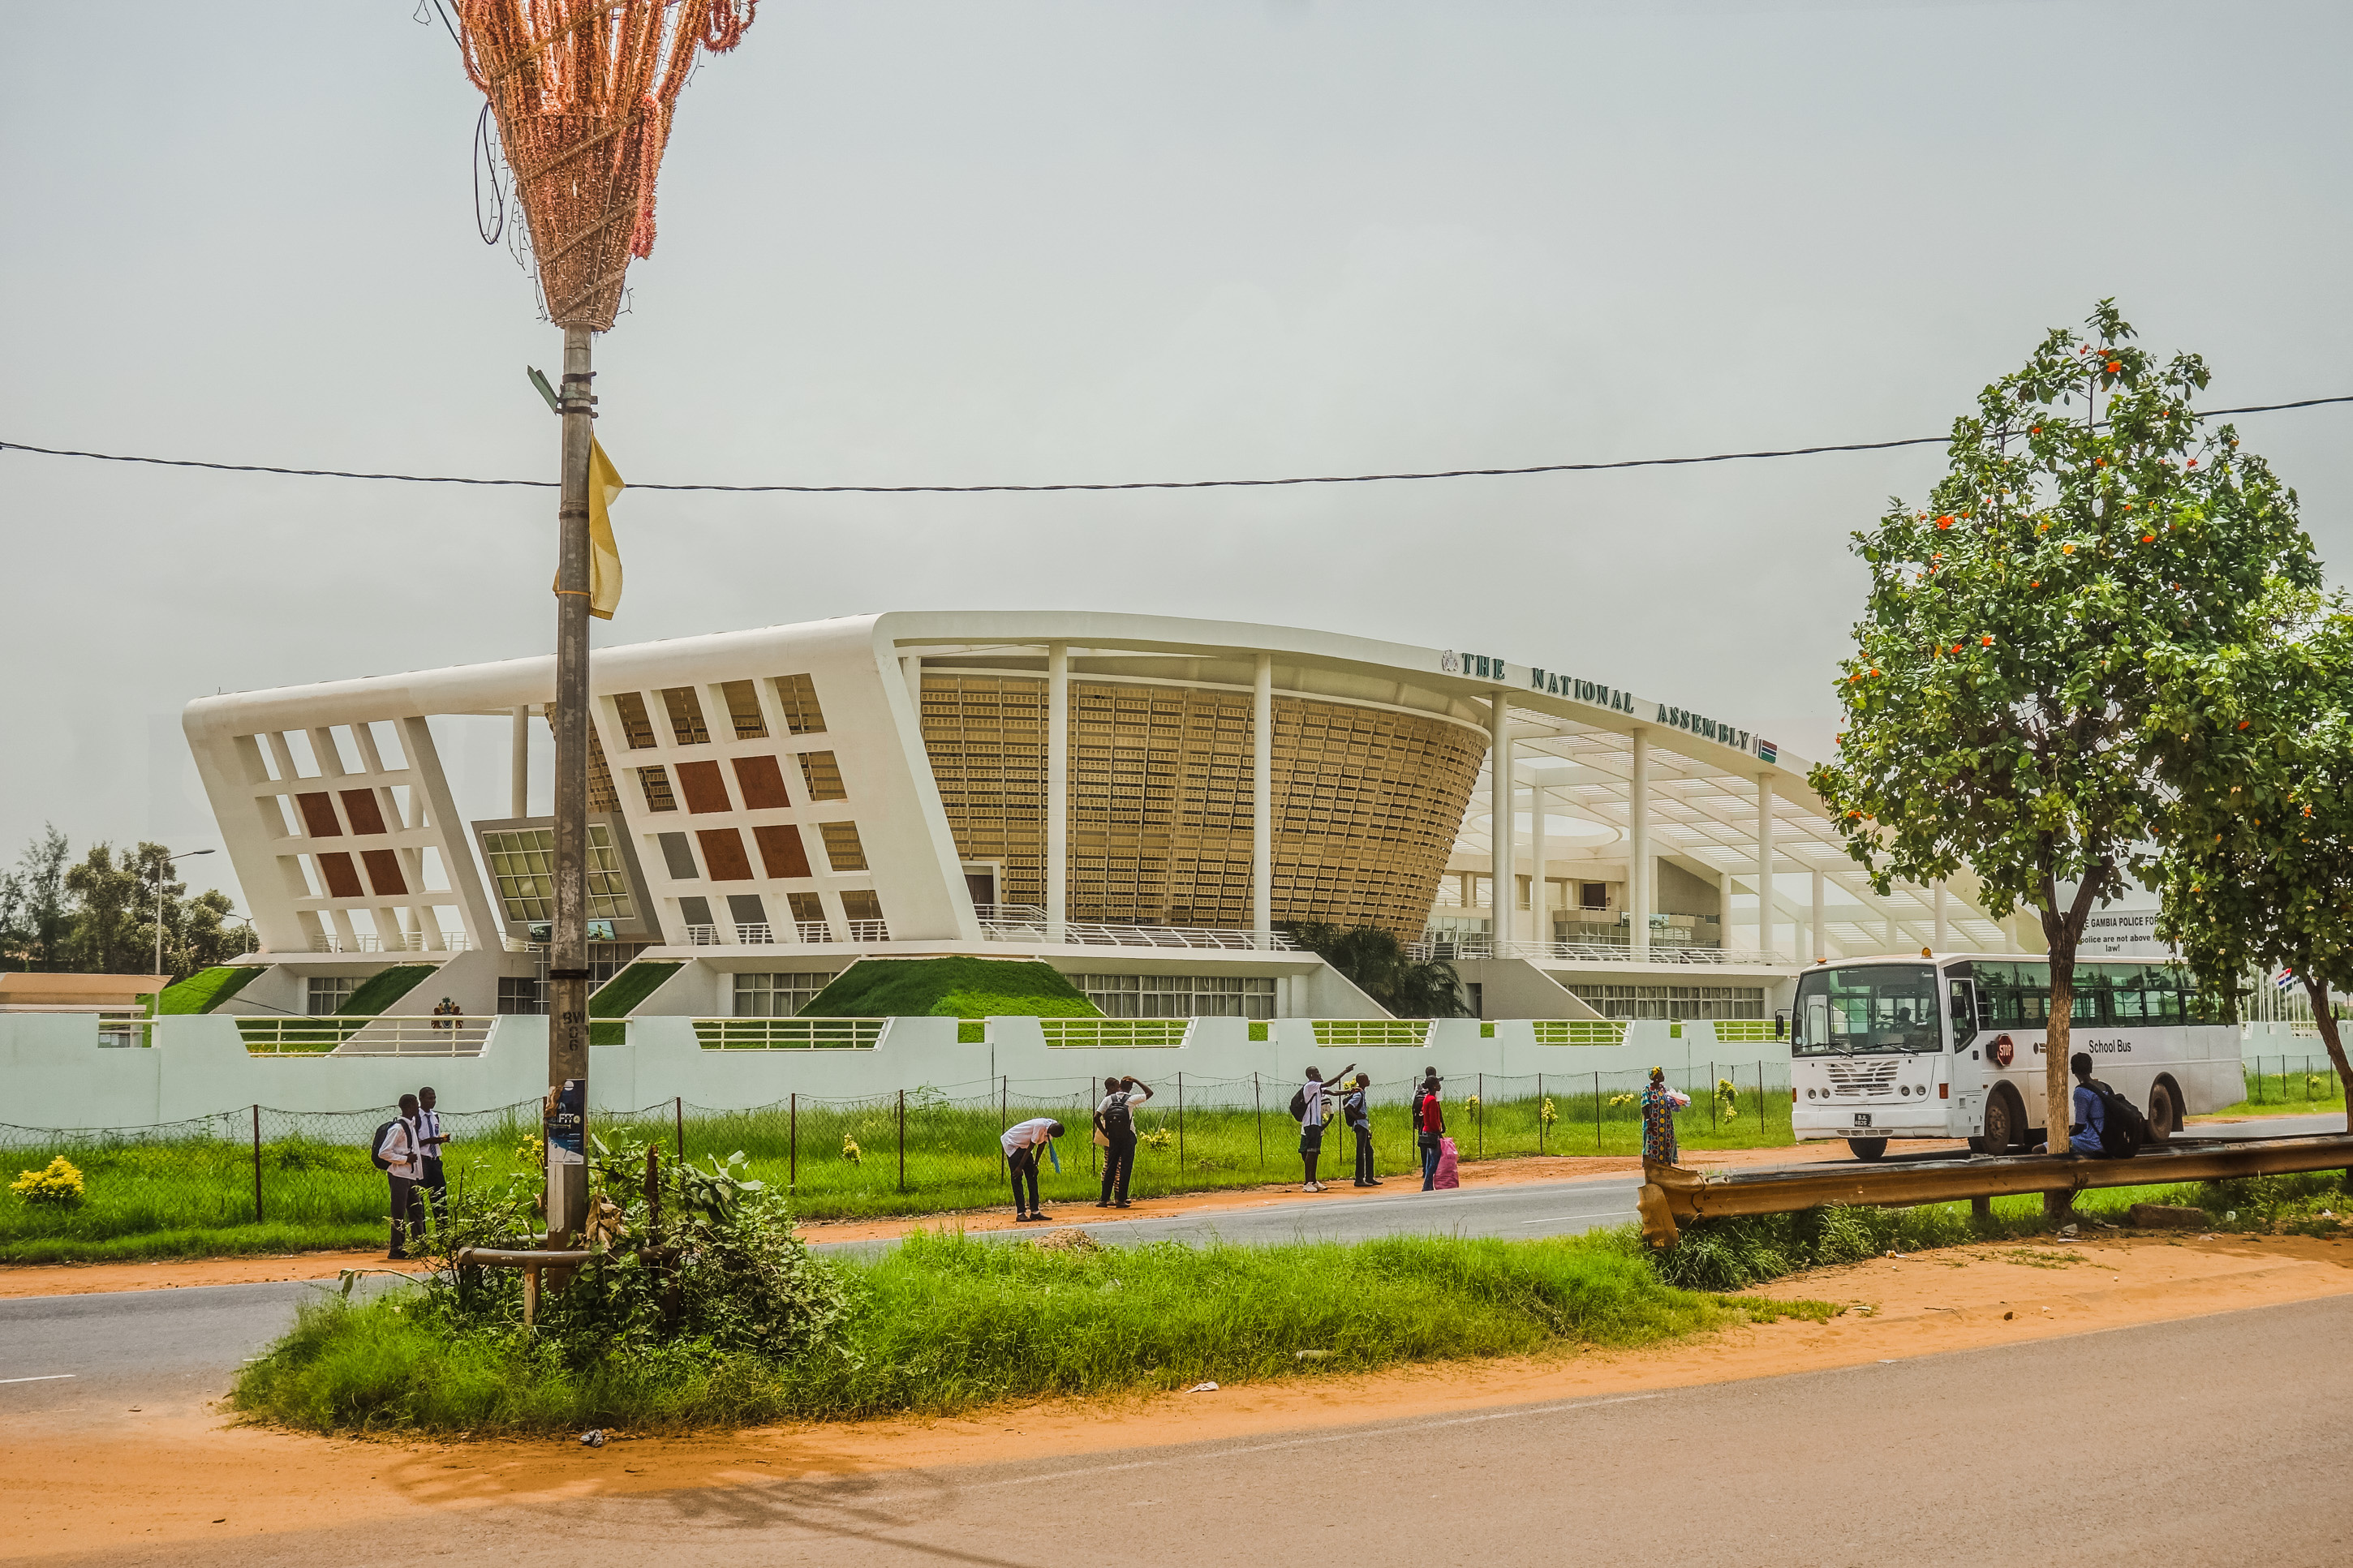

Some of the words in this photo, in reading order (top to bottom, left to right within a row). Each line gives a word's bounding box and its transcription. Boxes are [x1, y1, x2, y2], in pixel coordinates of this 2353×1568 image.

[1462, 652, 1505, 680] THE
[1532, 667, 1634, 714] NATIONAL
[1657, 703, 1750, 750] ASSEMBLY
[2091, 917, 2117, 928] GAMBIA
[2119, 917, 2143, 927] POLICE
[2117, 934, 2127, 943] not
[2130, 934, 2150, 942] above
[2106, 944, 2120, 952] law!
[1998, 1044, 2012, 1056] STOP
[2088, 1039, 2115, 1053] School
[2117, 1039, 2131, 1052] Bus
